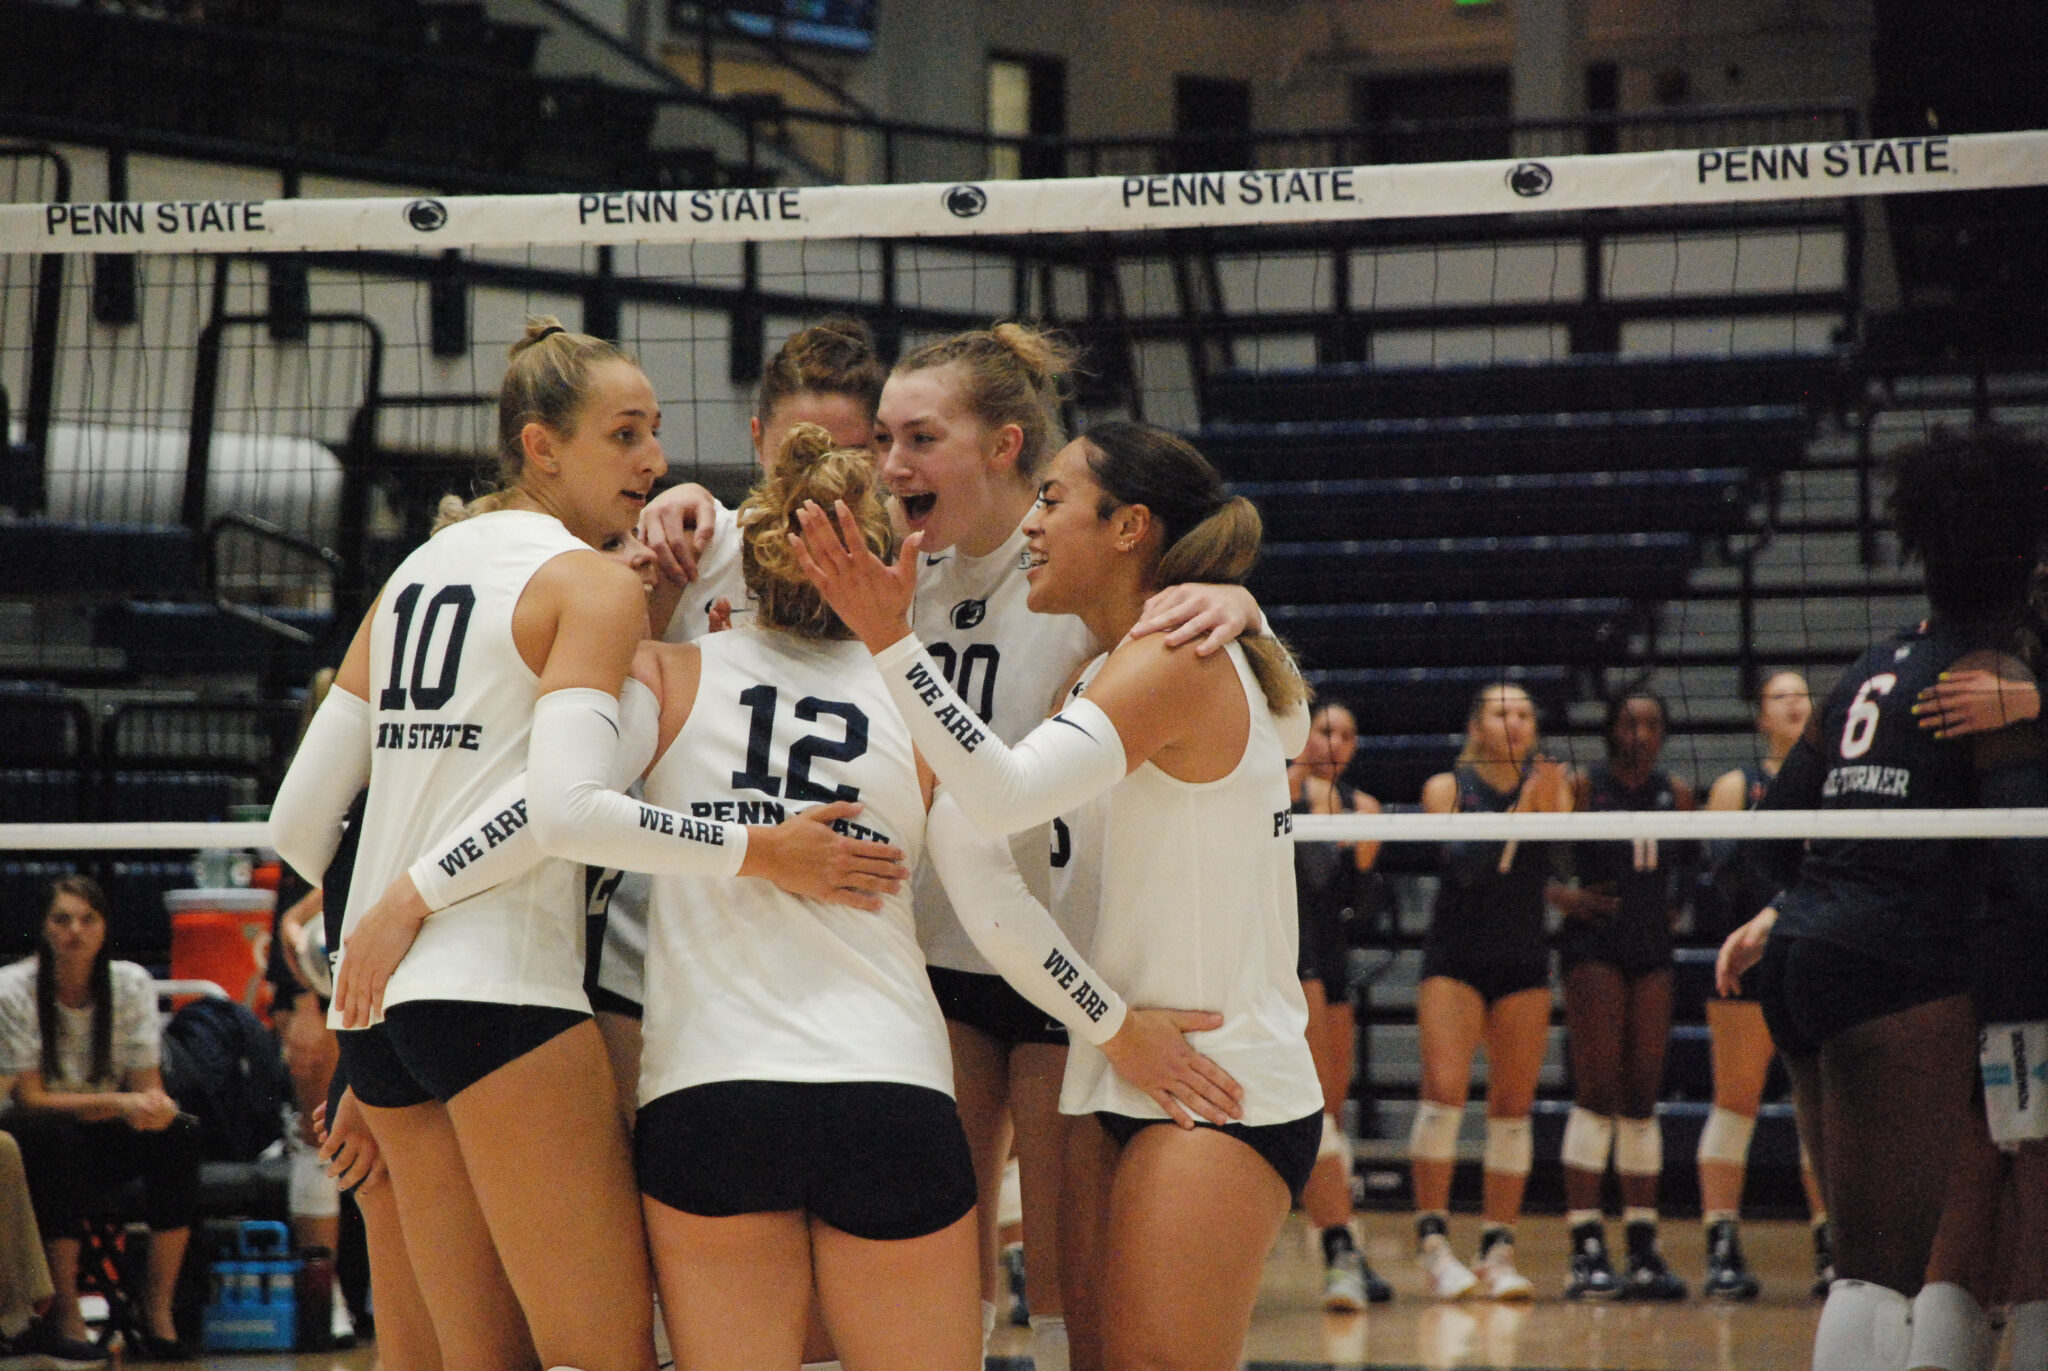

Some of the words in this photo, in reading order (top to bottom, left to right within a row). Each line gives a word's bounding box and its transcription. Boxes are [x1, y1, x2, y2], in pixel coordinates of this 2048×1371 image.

[1697, 145, 1809, 184] PENN
[1823, 139, 1949, 178] STATE
[579, 192, 679, 224] PENN
[690, 189, 801, 222] STATE
[1123, 174, 1226, 208] PENN
[1239, 170, 1355, 205] STATE
[47, 203, 145, 235] PENN
[157, 201, 266, 233] STATE
[379, 582, 476, 711] 10
[905, 662, 944, 708] WE
[934, 703, 986, 754] ARE
[1840, 671, 1897, 760] 6
[407, 724, 483, 751] STATE
[731, 684, 869, 804] 12
[639, 806, 673, 835] WE
[679, 817, 724, 846] ARE
[691, 801, 786, 826] PENN
[1273, 808, 1293, 838] PE
[438, 837, 484, 878] WE
[1043, 947, 1079, 991] WE
[1070, 980, 1109, 1023] ARE
